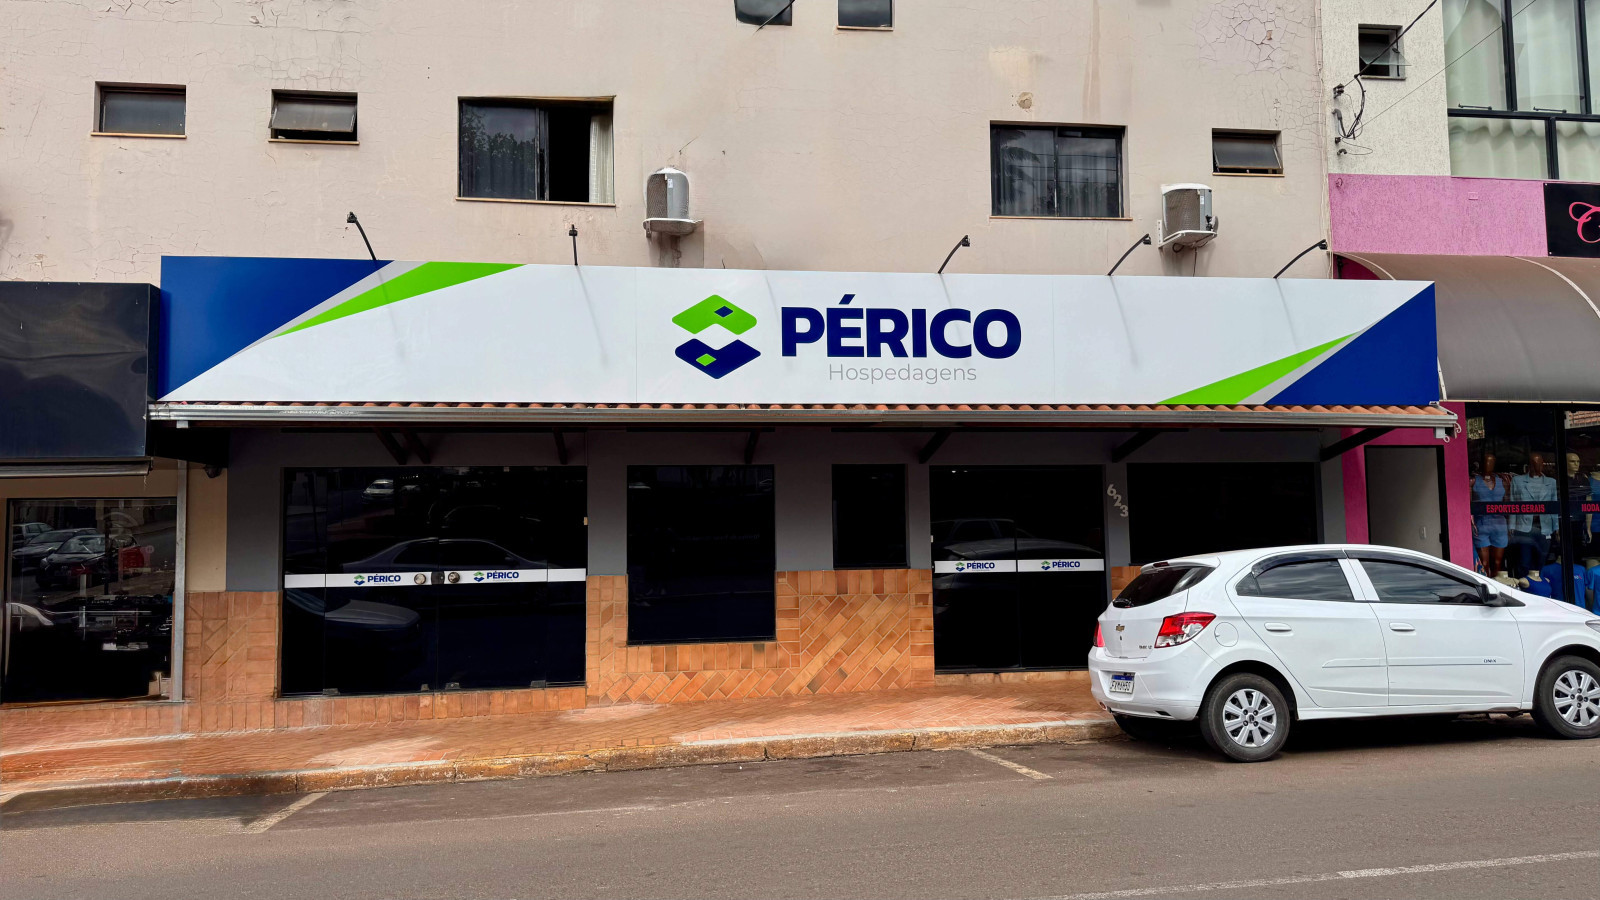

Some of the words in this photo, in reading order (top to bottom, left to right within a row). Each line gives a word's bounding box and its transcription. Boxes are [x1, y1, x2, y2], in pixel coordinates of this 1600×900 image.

[781, 293, 1022, 359] PÉRICO
[828, 363, 977, 384] Hospedagens
[1107, 484, 1128, 517] 623
[1486, 504, 1520, 513] ESPORTES
[1521, 504, 1545, 513] GERAIS
[966, 560, 995, 569] PÉRICO
[1052, 559, 1081, 568] PÉRICO
[367, 573, 401, 582] PÉRICO
[486, 570, 519, 579] PÉRICO
